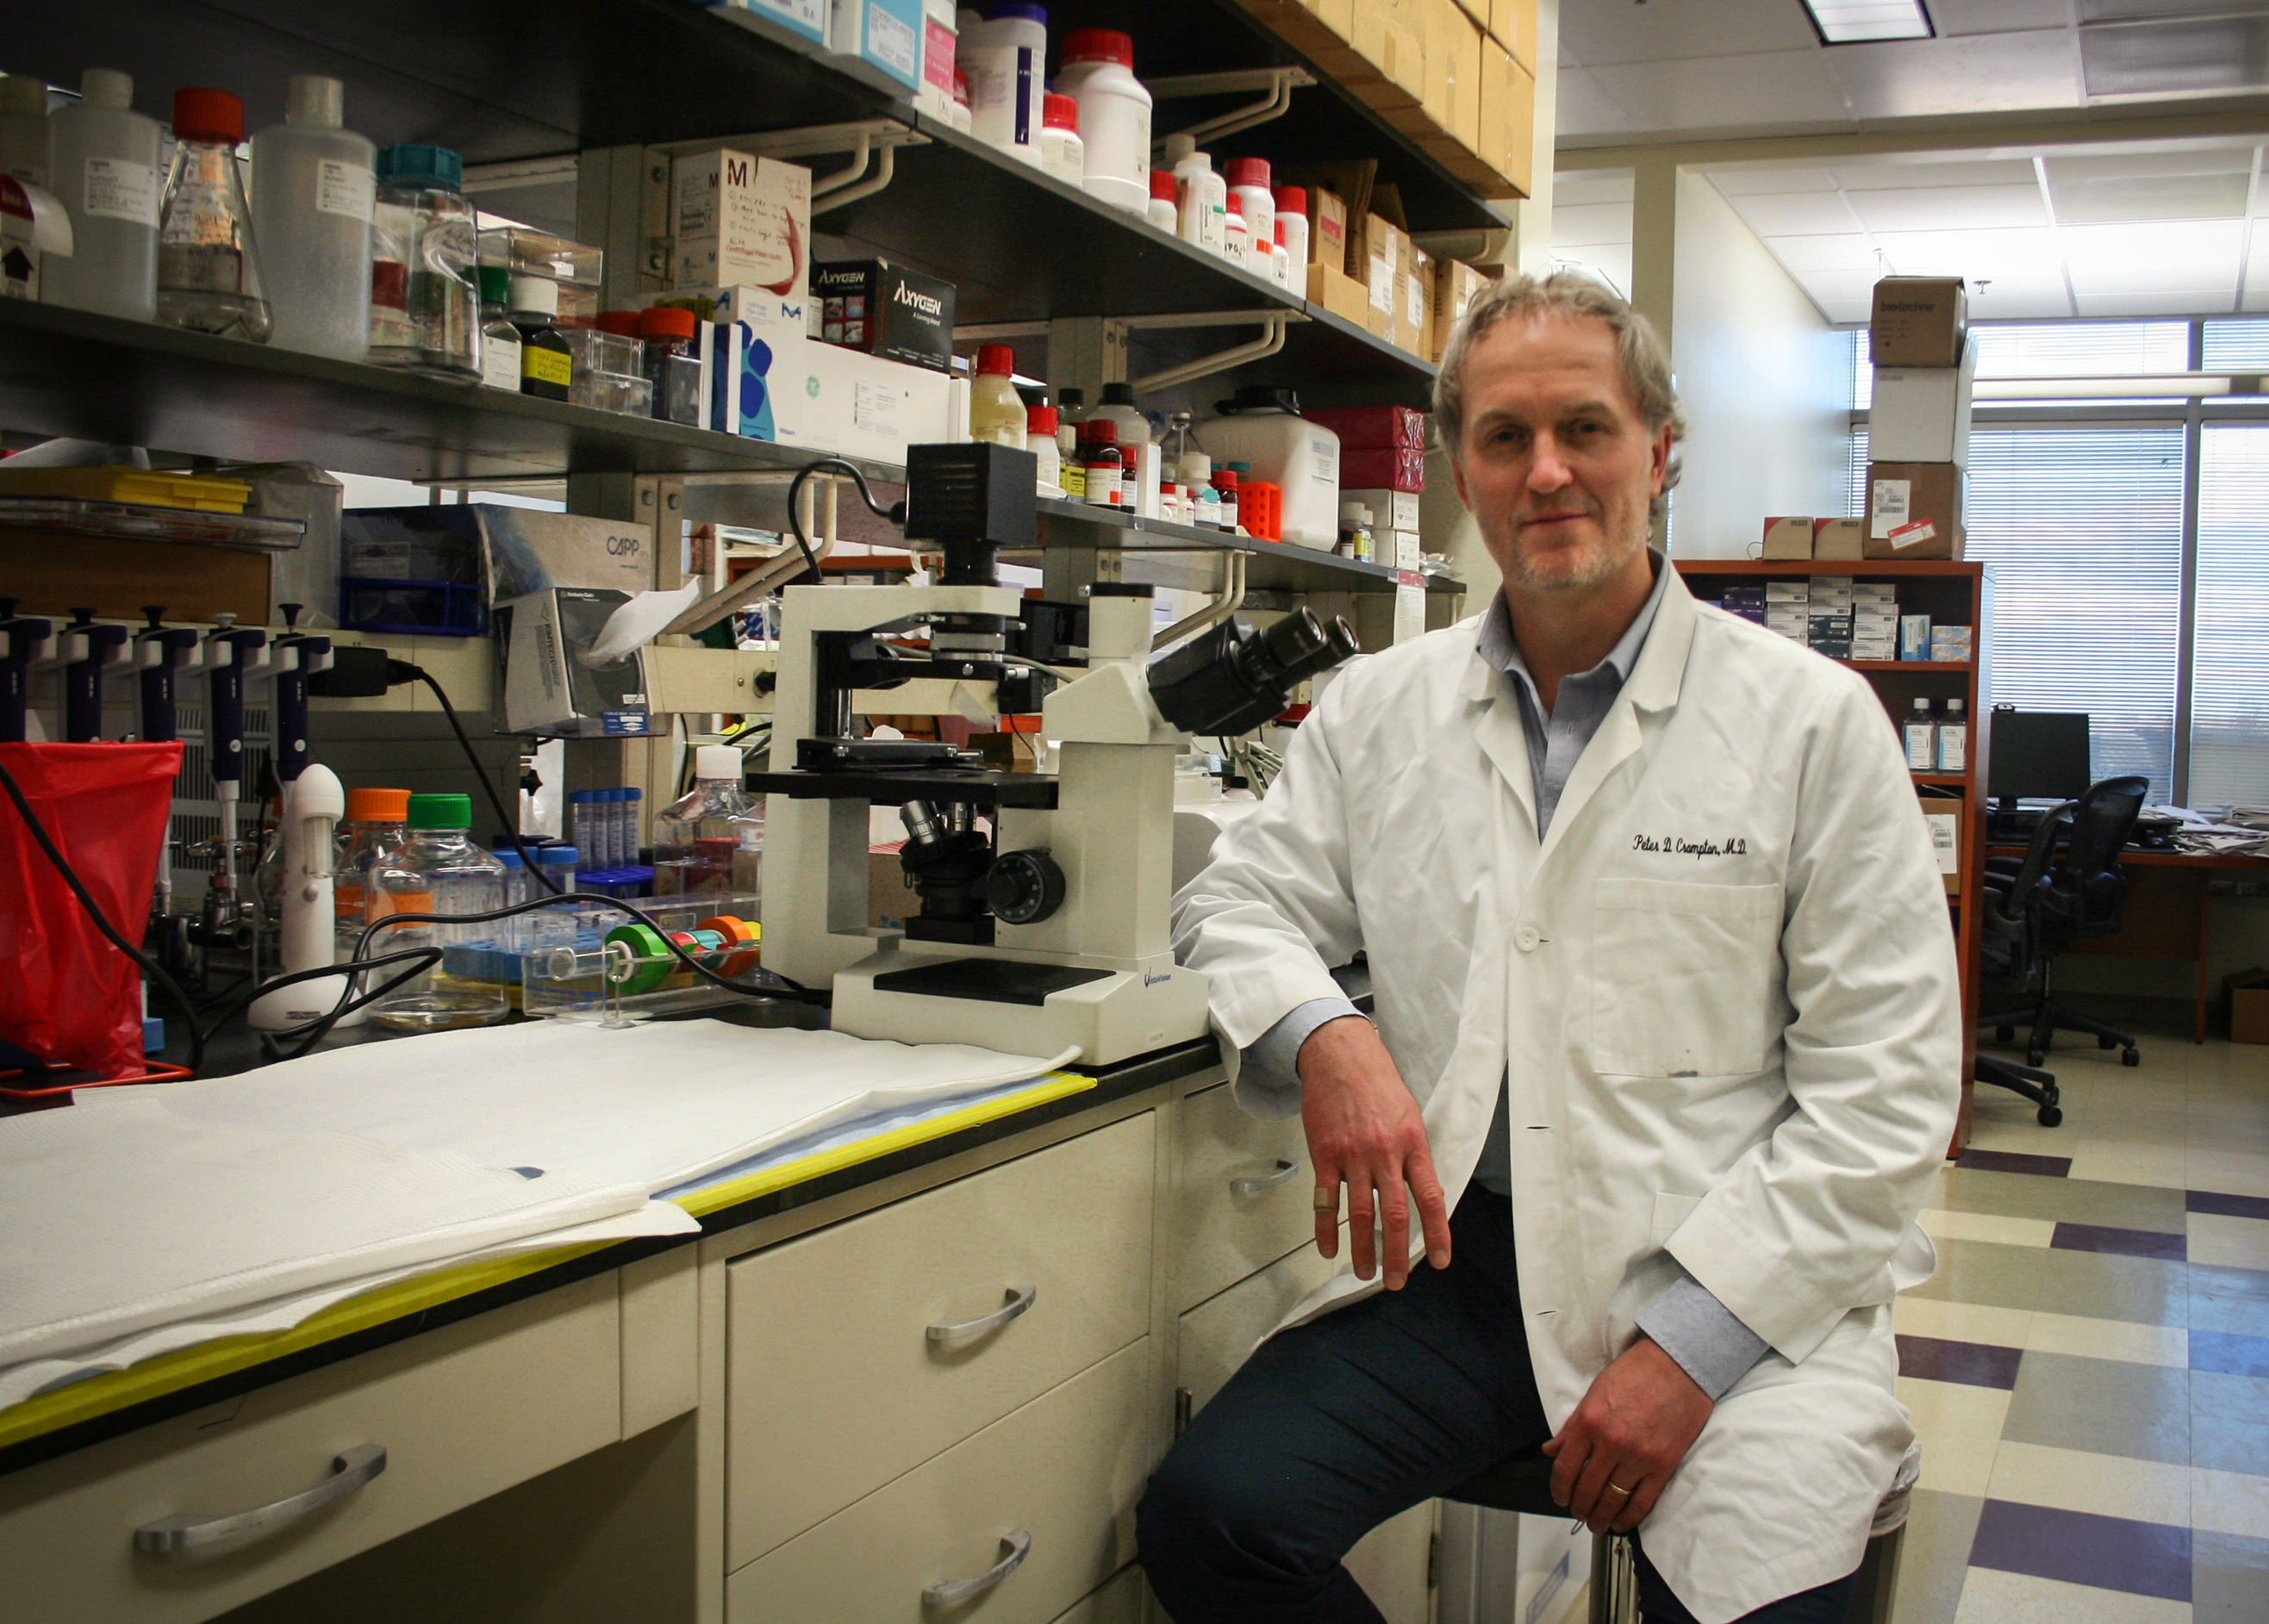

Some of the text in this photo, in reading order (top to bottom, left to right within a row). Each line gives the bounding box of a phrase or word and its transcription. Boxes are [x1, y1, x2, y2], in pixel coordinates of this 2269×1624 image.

[727, 158, 747, 188] M
[819, 269, 865, 284] AXYGEN
[894, 279, 942, 315] AXYGEN
[607, 536, 639, 557] CAPP
[1633, 834, 1659, 852] Peter
[1722, 837, 1747, 855] M.D.
